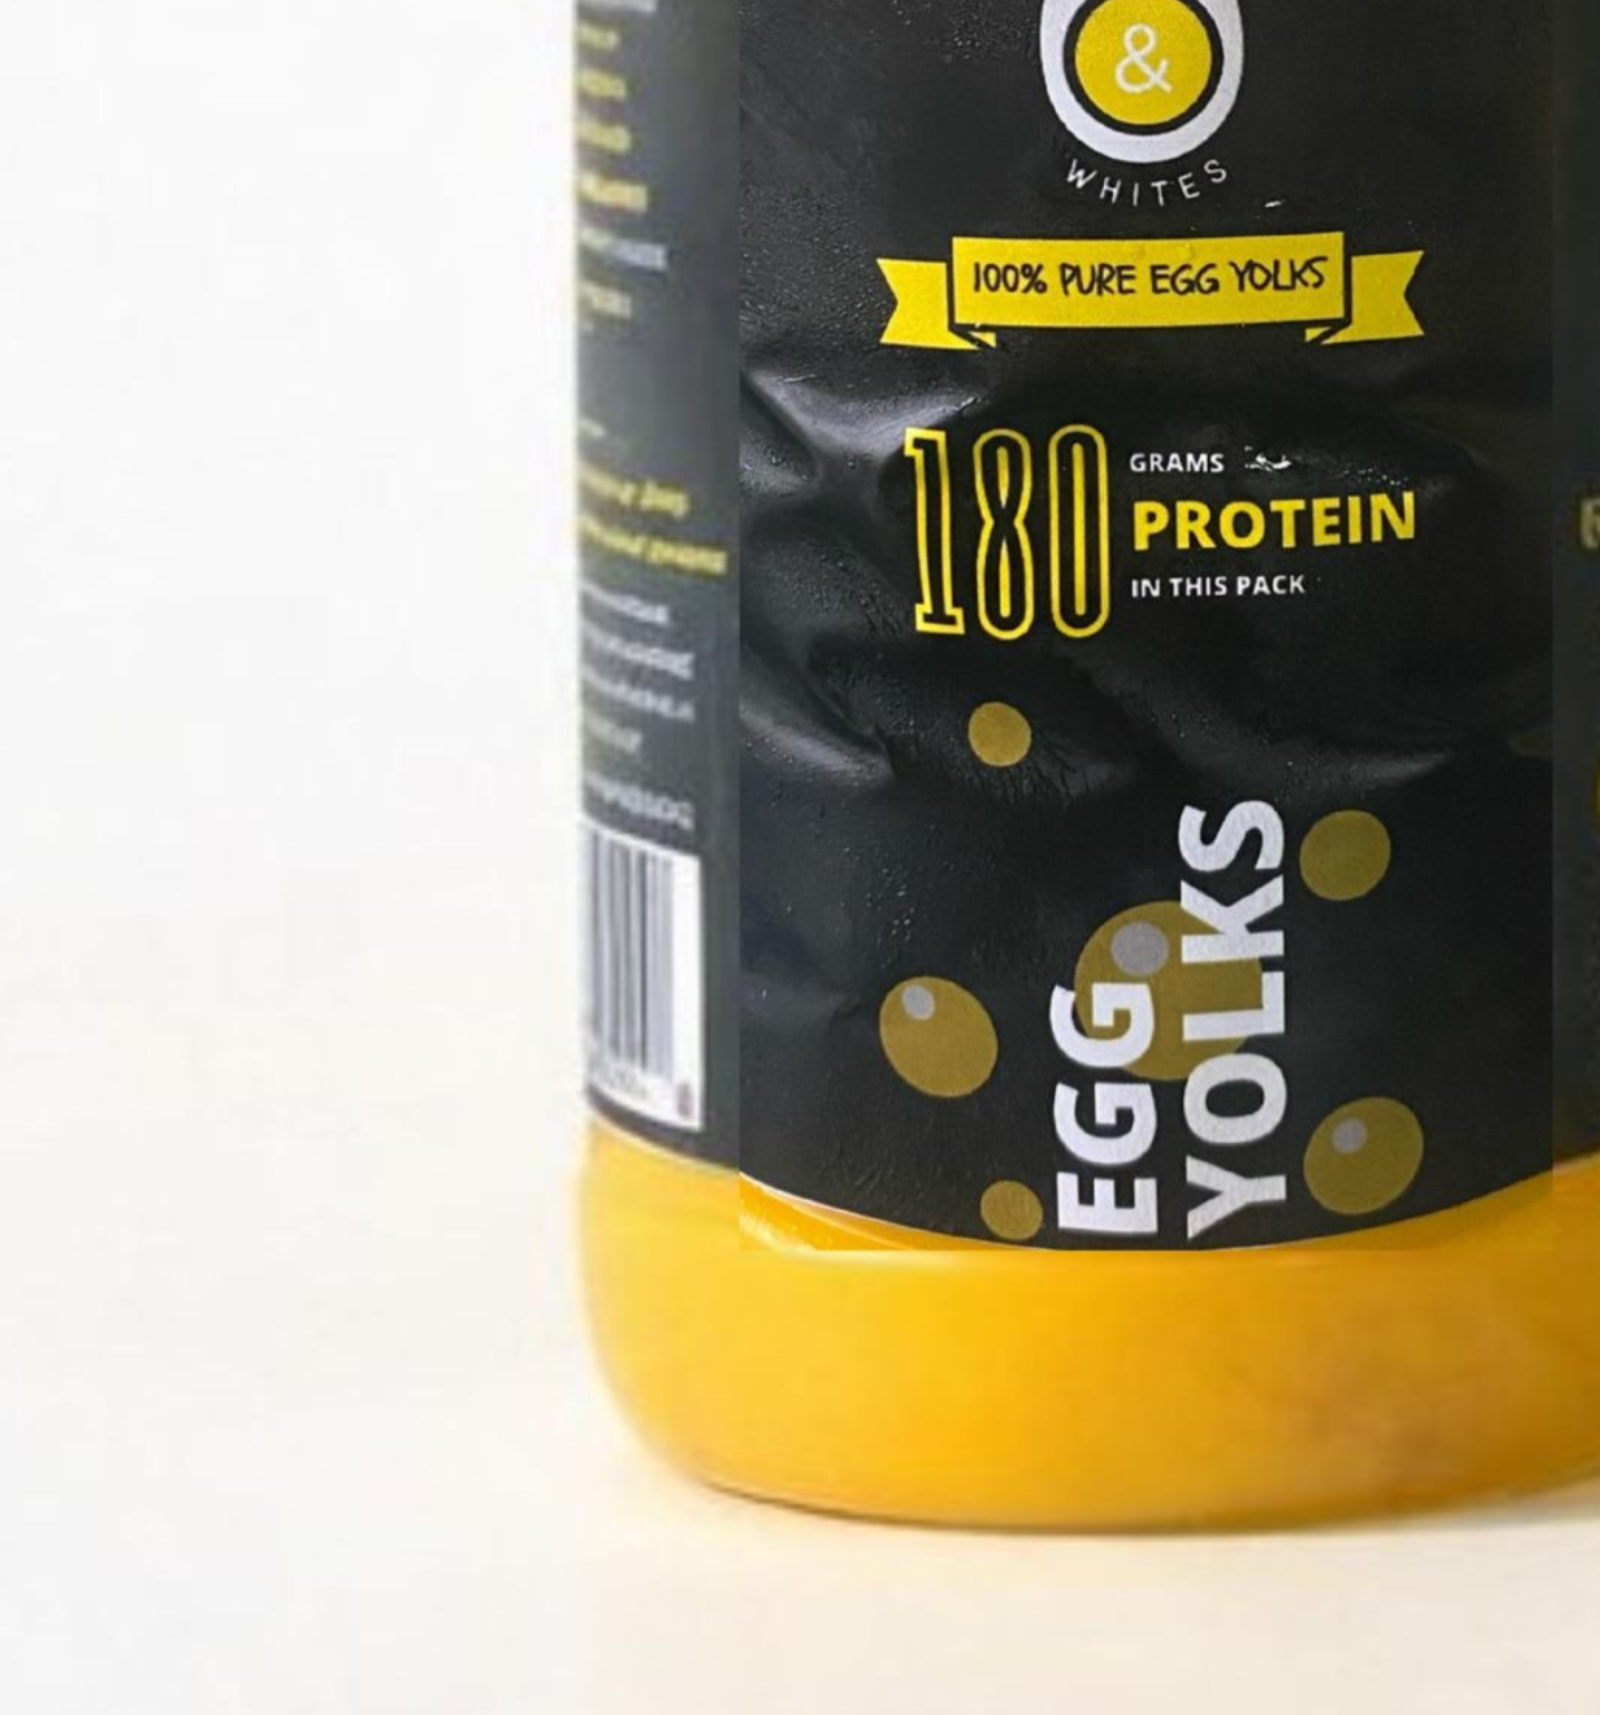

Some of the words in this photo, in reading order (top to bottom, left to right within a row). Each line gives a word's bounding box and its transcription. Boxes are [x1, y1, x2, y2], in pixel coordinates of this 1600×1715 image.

[1112, 21, 1175, 95] &
[1064, 155, 1230, 208] WHITES
[972, 261, 1049, 296] 100%
[1057, 260, 1138, 298] PURE
[1148, 261, 1222, 298] EGG
[1227, 253, 1330, 294] YOLKS
[1128, 450, 1226, 475] GRAMS
[900, 422, 1112, 643] 180
[1131, 489, 1417, 553] PROTEIN
[1129, 576, 1162, 600] IN
[1167, 574, 1229, 599] THIS
[1234, 573, 1306, 598] PACK
[1176, 794, 1290, 1241] YOLKS
[1047, 981, 1159, 1235] EGG
